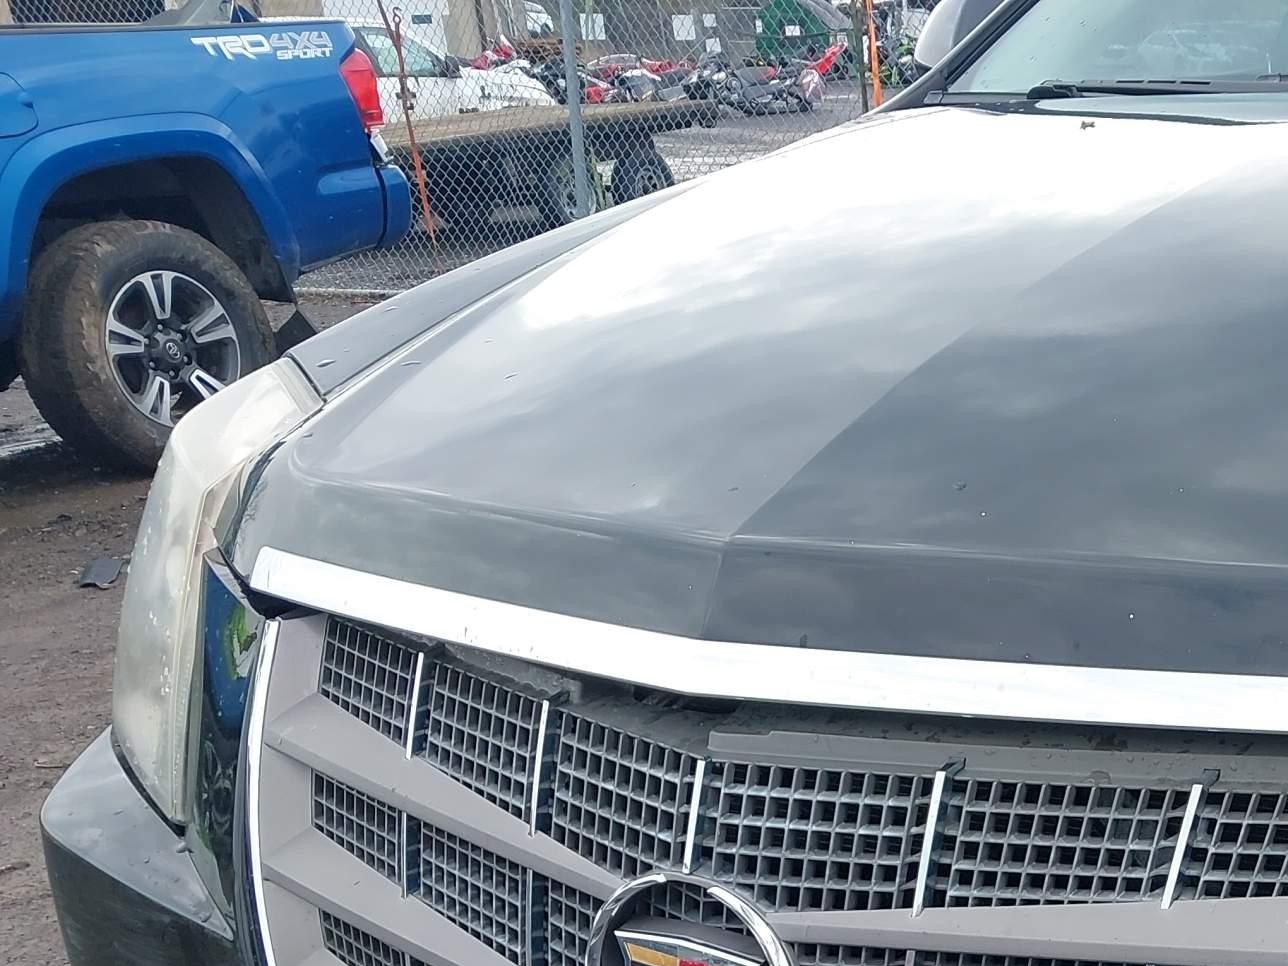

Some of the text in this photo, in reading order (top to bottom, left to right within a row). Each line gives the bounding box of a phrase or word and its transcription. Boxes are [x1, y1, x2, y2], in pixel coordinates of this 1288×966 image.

[190, 31, 333, 60] TRD 4X4
[277, 47, 333, 60] SPORT
